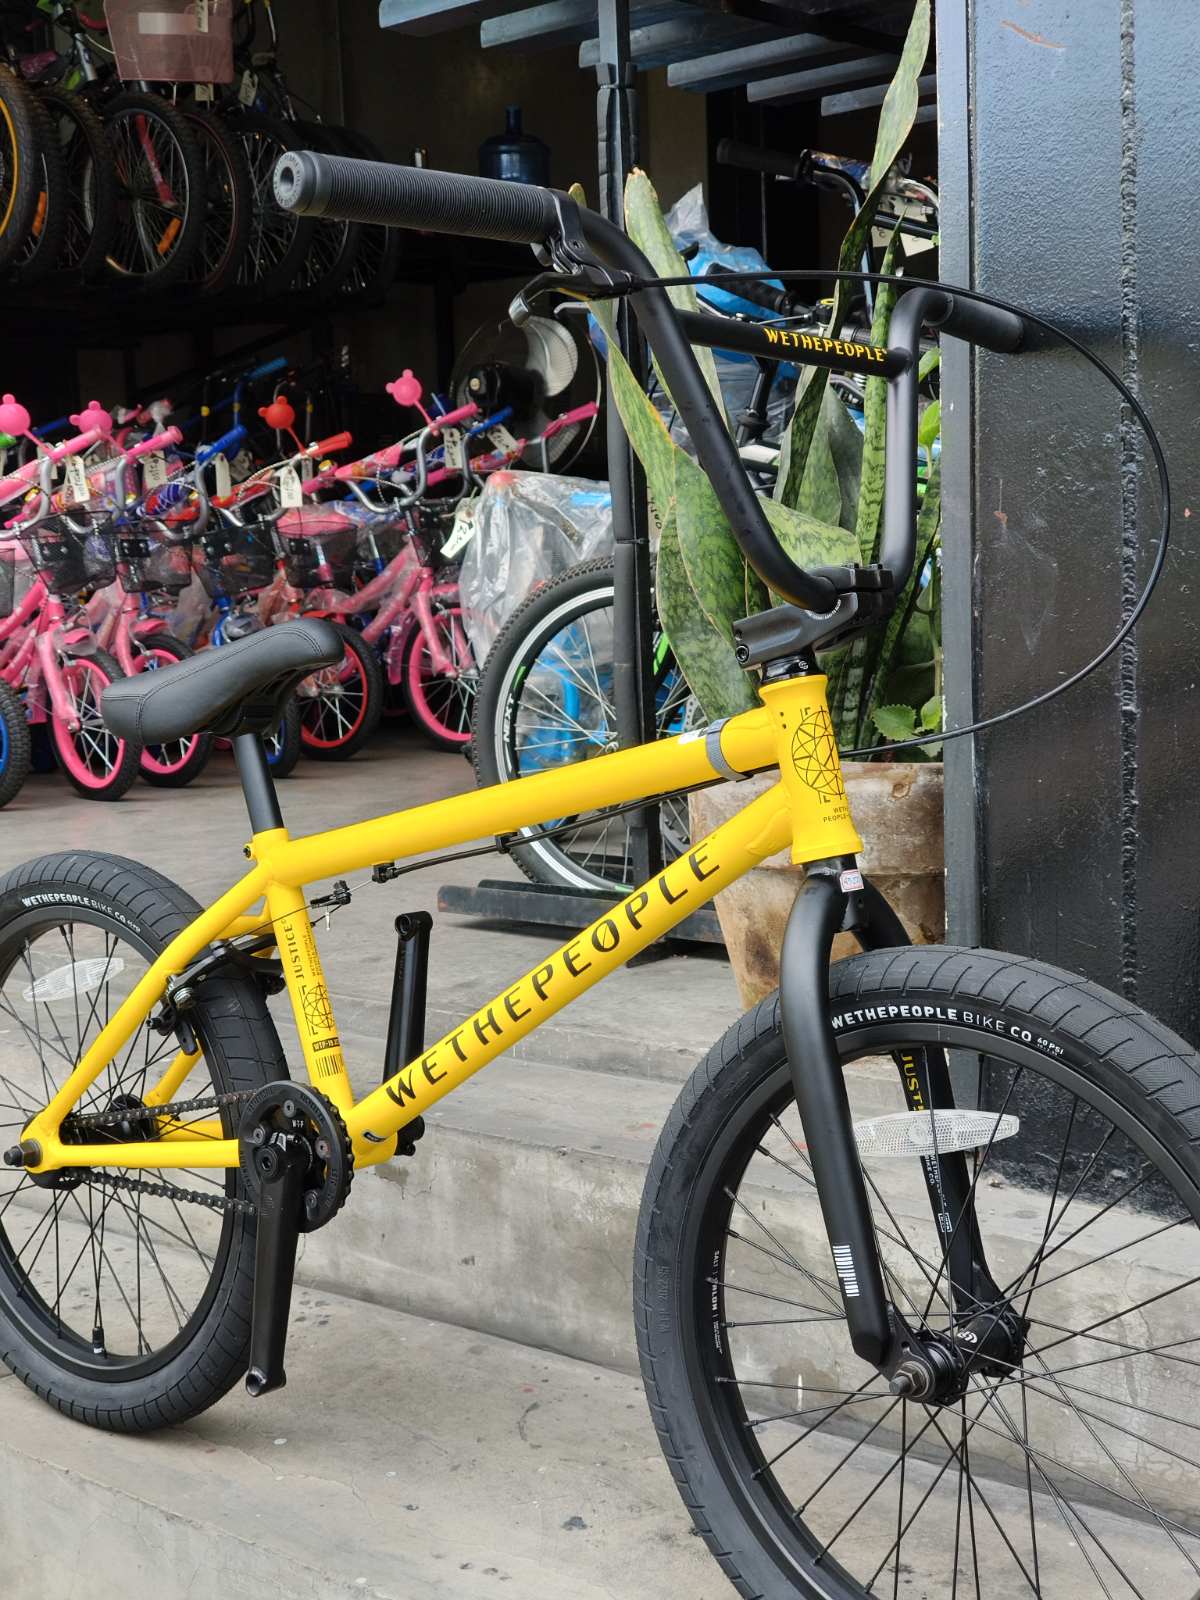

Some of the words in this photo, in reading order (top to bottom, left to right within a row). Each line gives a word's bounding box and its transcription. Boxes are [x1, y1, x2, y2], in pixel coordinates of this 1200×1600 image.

[21, 893, 91, 908] WETHEPEOPLE
[91, 899, 113, 914] BIKE
[114, 911, 126, 924] CO
[283, 923, 305, 979] JUSTICE
[831, 1004, 958, 1030] WETHEPEOPLE
[963, 1011, 1006, 1033] BIKE
[1010, 1026, 1032, 1042] CO
[1048, 1042, 1064, 1055] PSI
